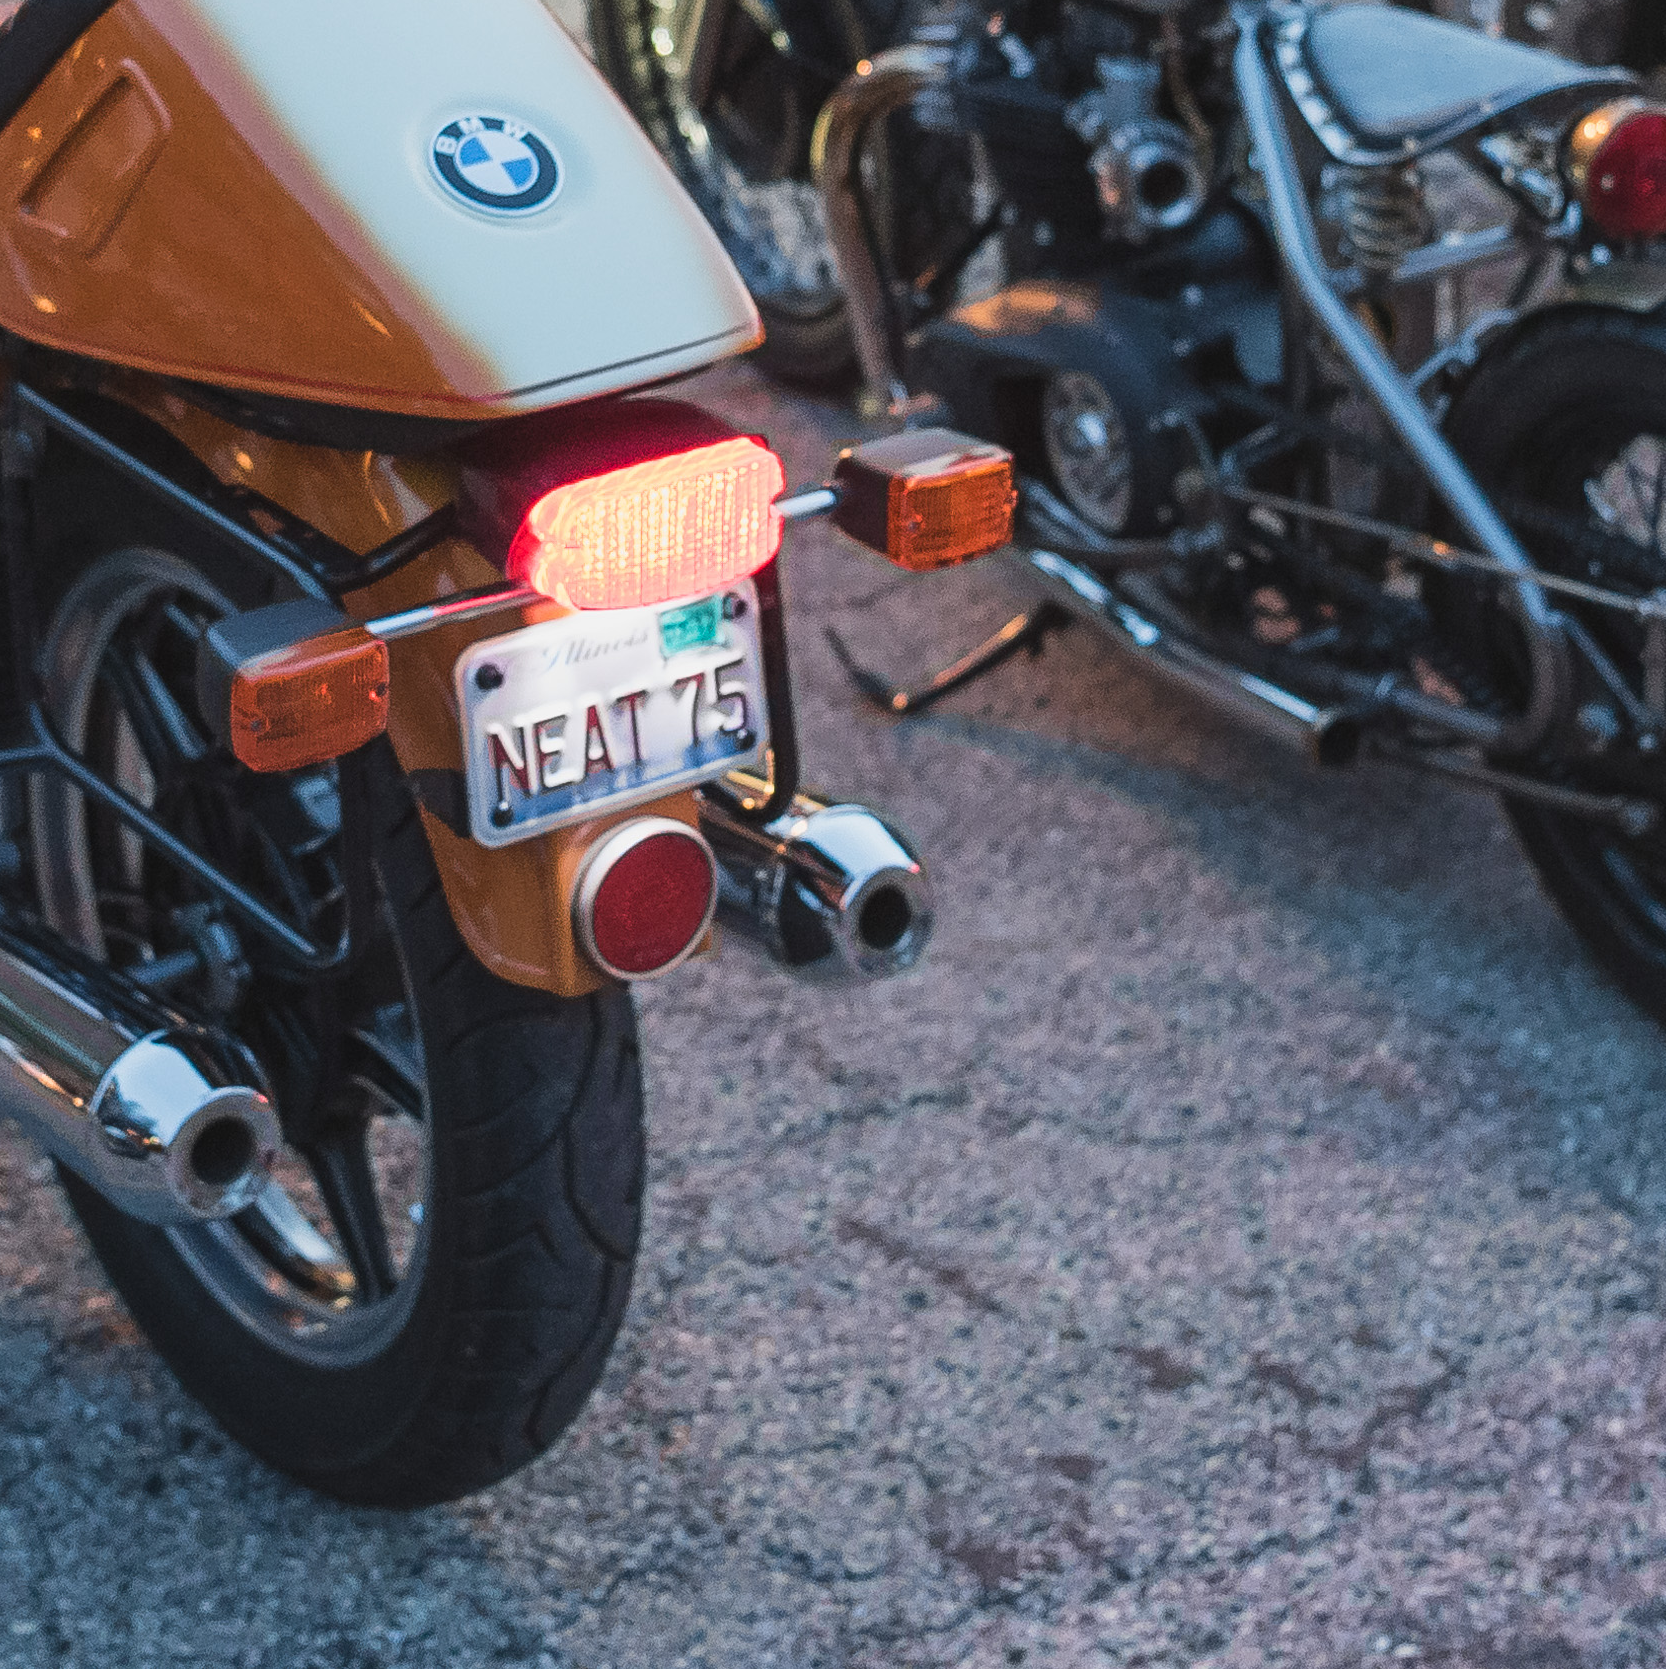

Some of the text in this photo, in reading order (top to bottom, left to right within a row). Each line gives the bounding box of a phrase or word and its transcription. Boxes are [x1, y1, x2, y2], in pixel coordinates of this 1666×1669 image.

[436, 116, 528, 155] BMW
[487, 657, 748, 800] NEAT 75
